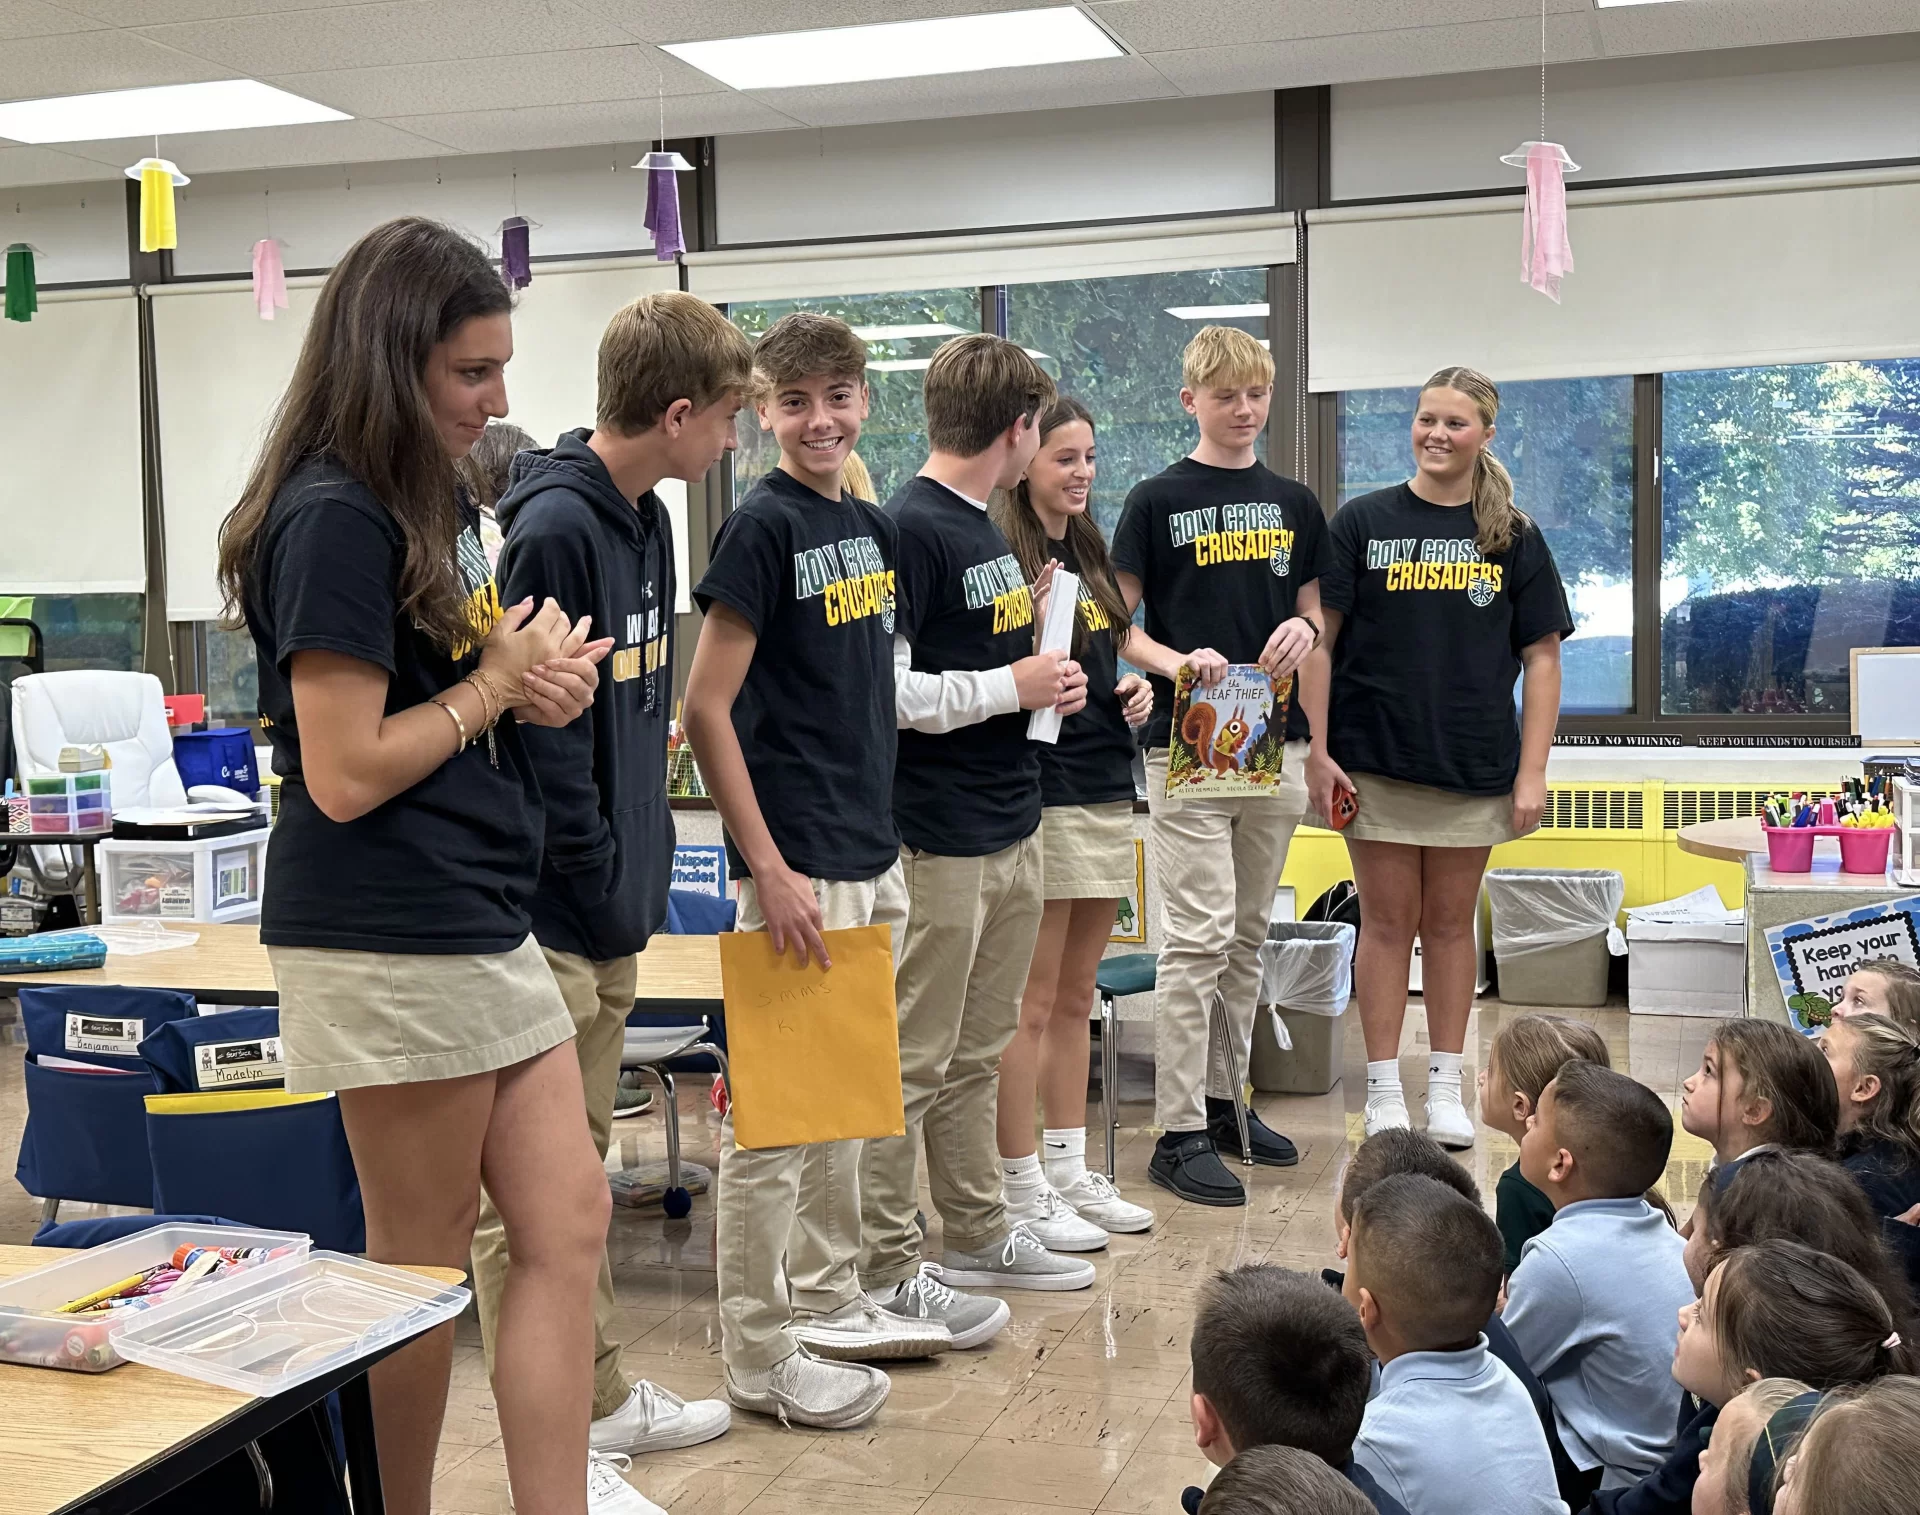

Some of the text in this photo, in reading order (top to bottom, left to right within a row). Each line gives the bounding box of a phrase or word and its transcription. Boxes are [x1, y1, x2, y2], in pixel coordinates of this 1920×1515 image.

[1168, 502, 1283, 548] HOLY CROSS
[1195, 528, 1295, 567] CRUSADERS
[1367, 538, 1417, 570] HOLY
[794, 543, 842, 600] HOLY
[962, 559, 1008, 610] HOLY
[1386, 561, 1503, 592] CRUSADERS
[1205, 688, 1265, 701] LEAF THIEF
[1605, 735, 1622, 745] NO
[1626, 735, 1681, 746] WHINING
[1699, 736, 1861, 746] KEEP YOUR HANDS TO YOURSELF
[1802, 932, 1901, 965] Keep your
[77, 1036, 119, 1053] Benjamin
[216, 1067, 263, 1083] Madelyn
